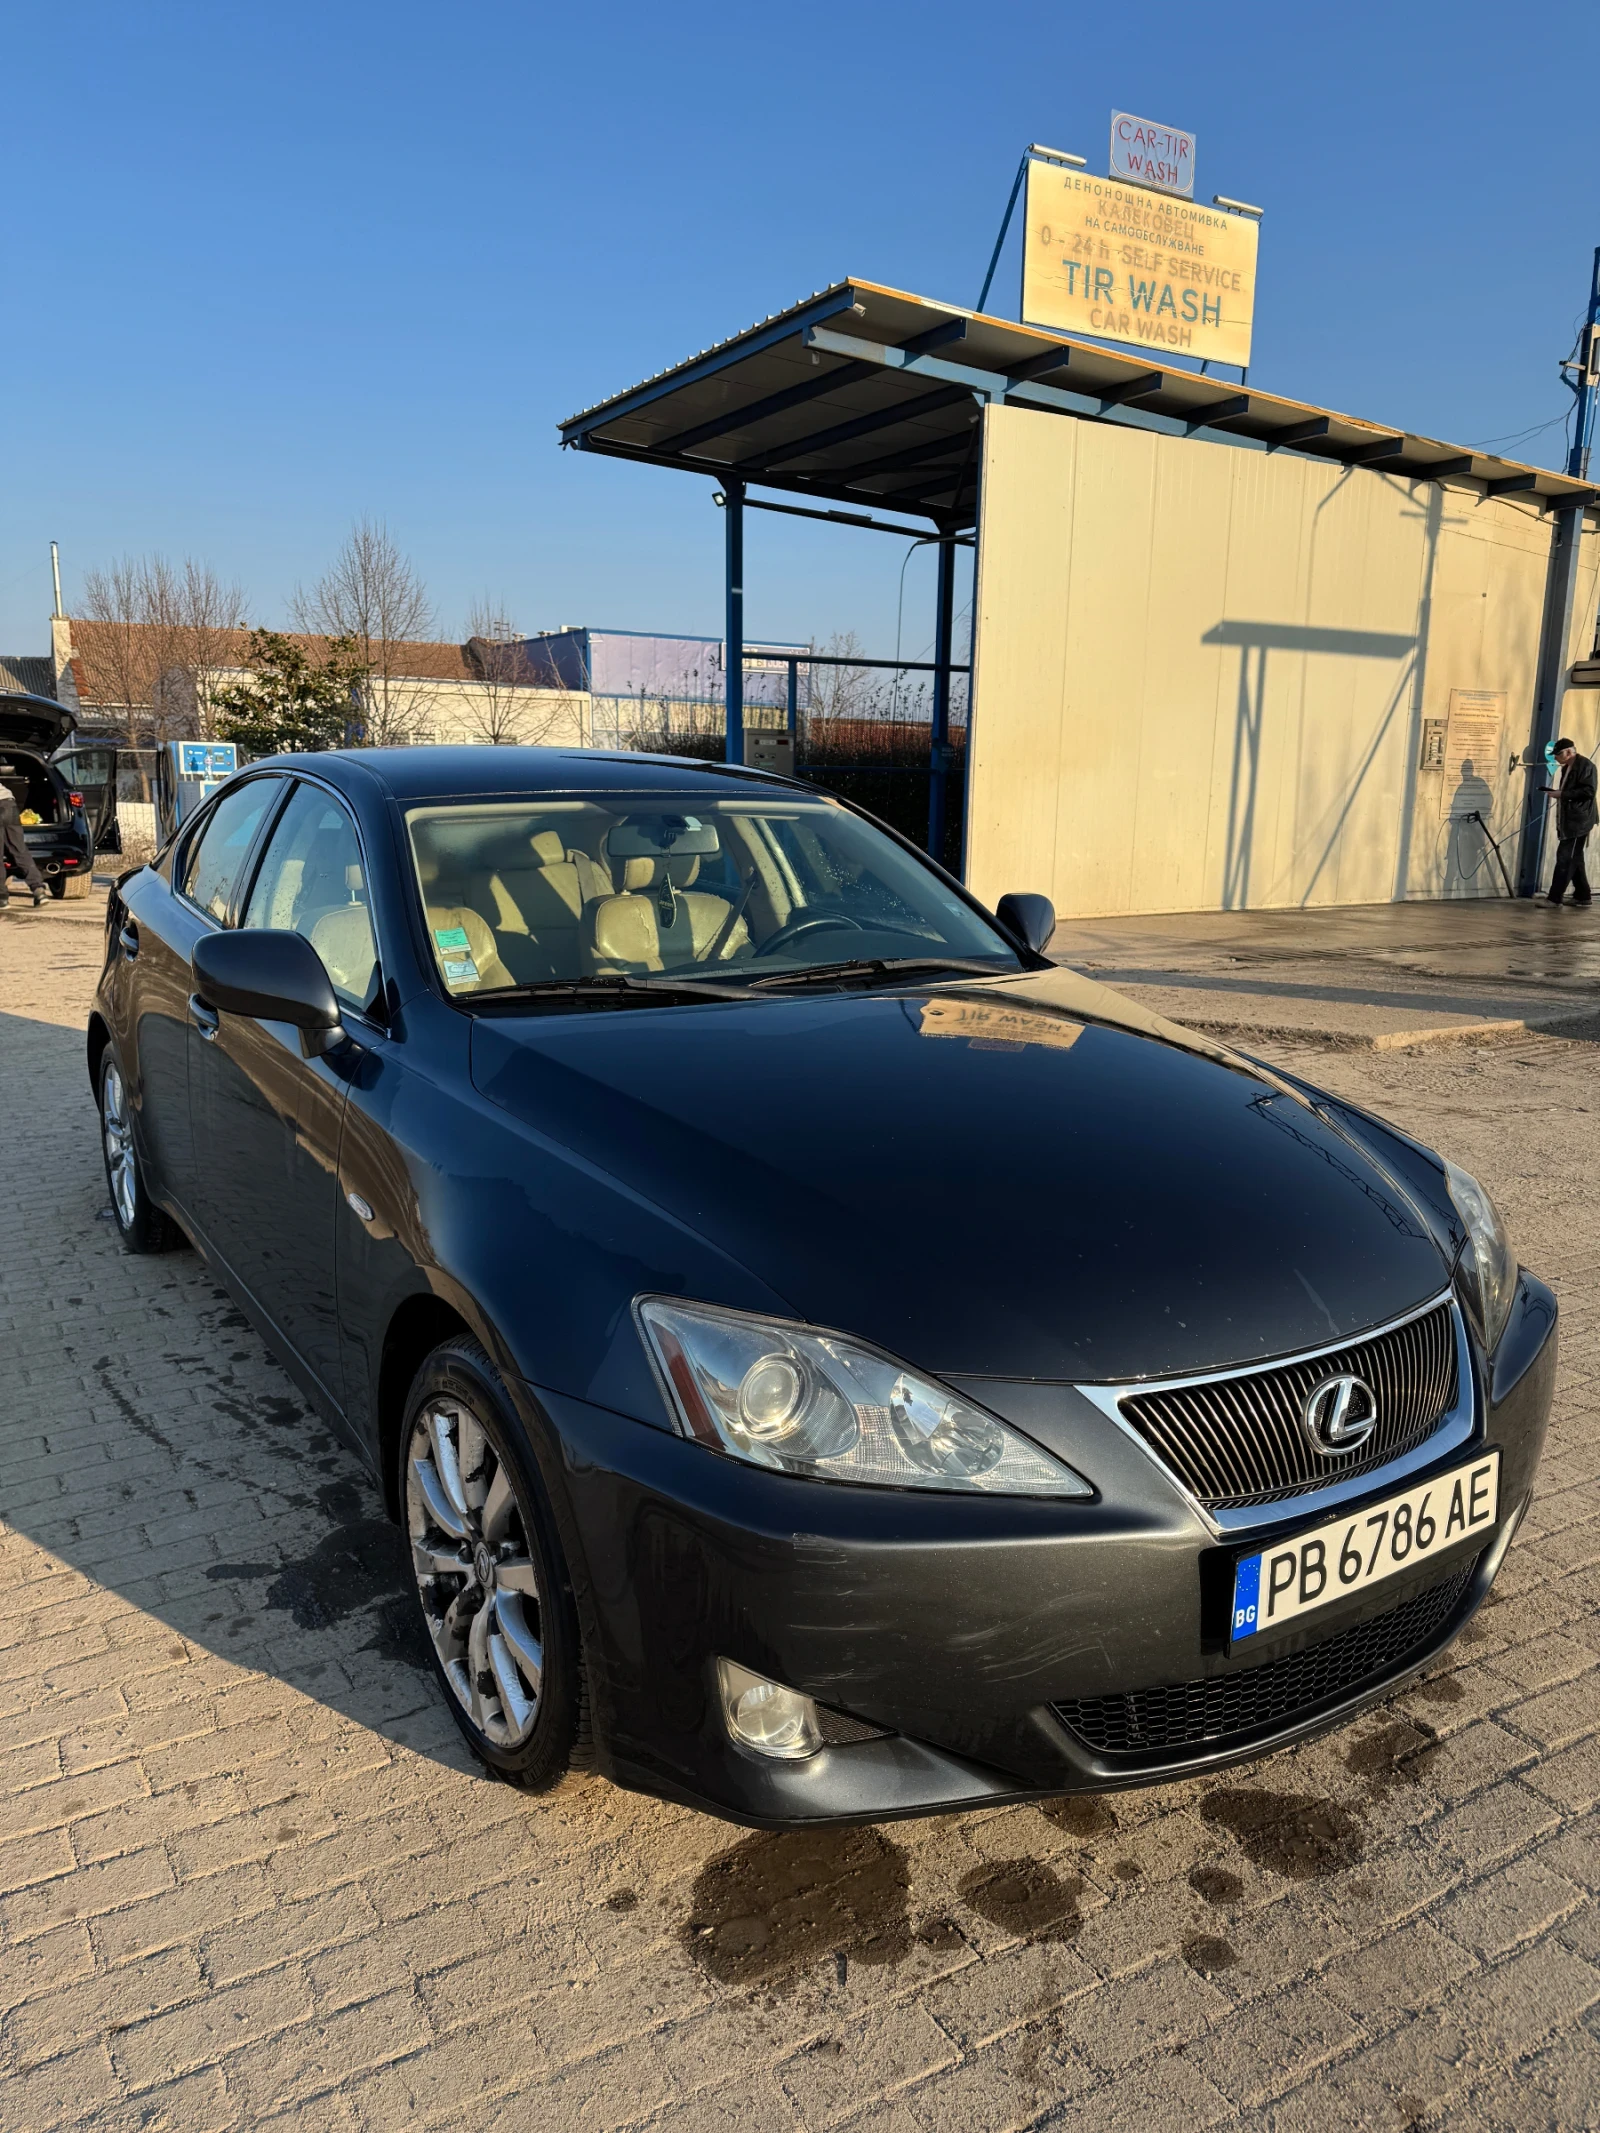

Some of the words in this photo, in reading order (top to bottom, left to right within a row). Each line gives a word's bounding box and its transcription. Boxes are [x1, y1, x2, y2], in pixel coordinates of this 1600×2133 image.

[1118, 120, 1189, 158] CAR-TIR
[1127, 152, 1178, 184] WASH
[1063, 177, 1153, 210] ДЕНОНОЩНА
[1158, 203, 1228, 230] АВТОМИВКА
[1085, 216, 1101, 230] НА
[1103, 220, 1205, 256] САМООБСЛУЖВАНЕ
[1071, 233, 1093, 256] 24
[1122, 245, 1164, 272] SELF
[1168, 257, 1242, 292] SERVICE
[1062, 259, 1114, 305] TIR
[1129, 274, 1222, 328] WASH
[1090, 308, 1130, 335] CAR
[1137, 317, 1192, 348] WASH
[1267, 1539, 1327, 1617] PB
[1338, 1491, 1437, 1585] 6786
[1444, 1464, 1492, 1539] AE
[1235, 1605, 1256, 1629] BG
